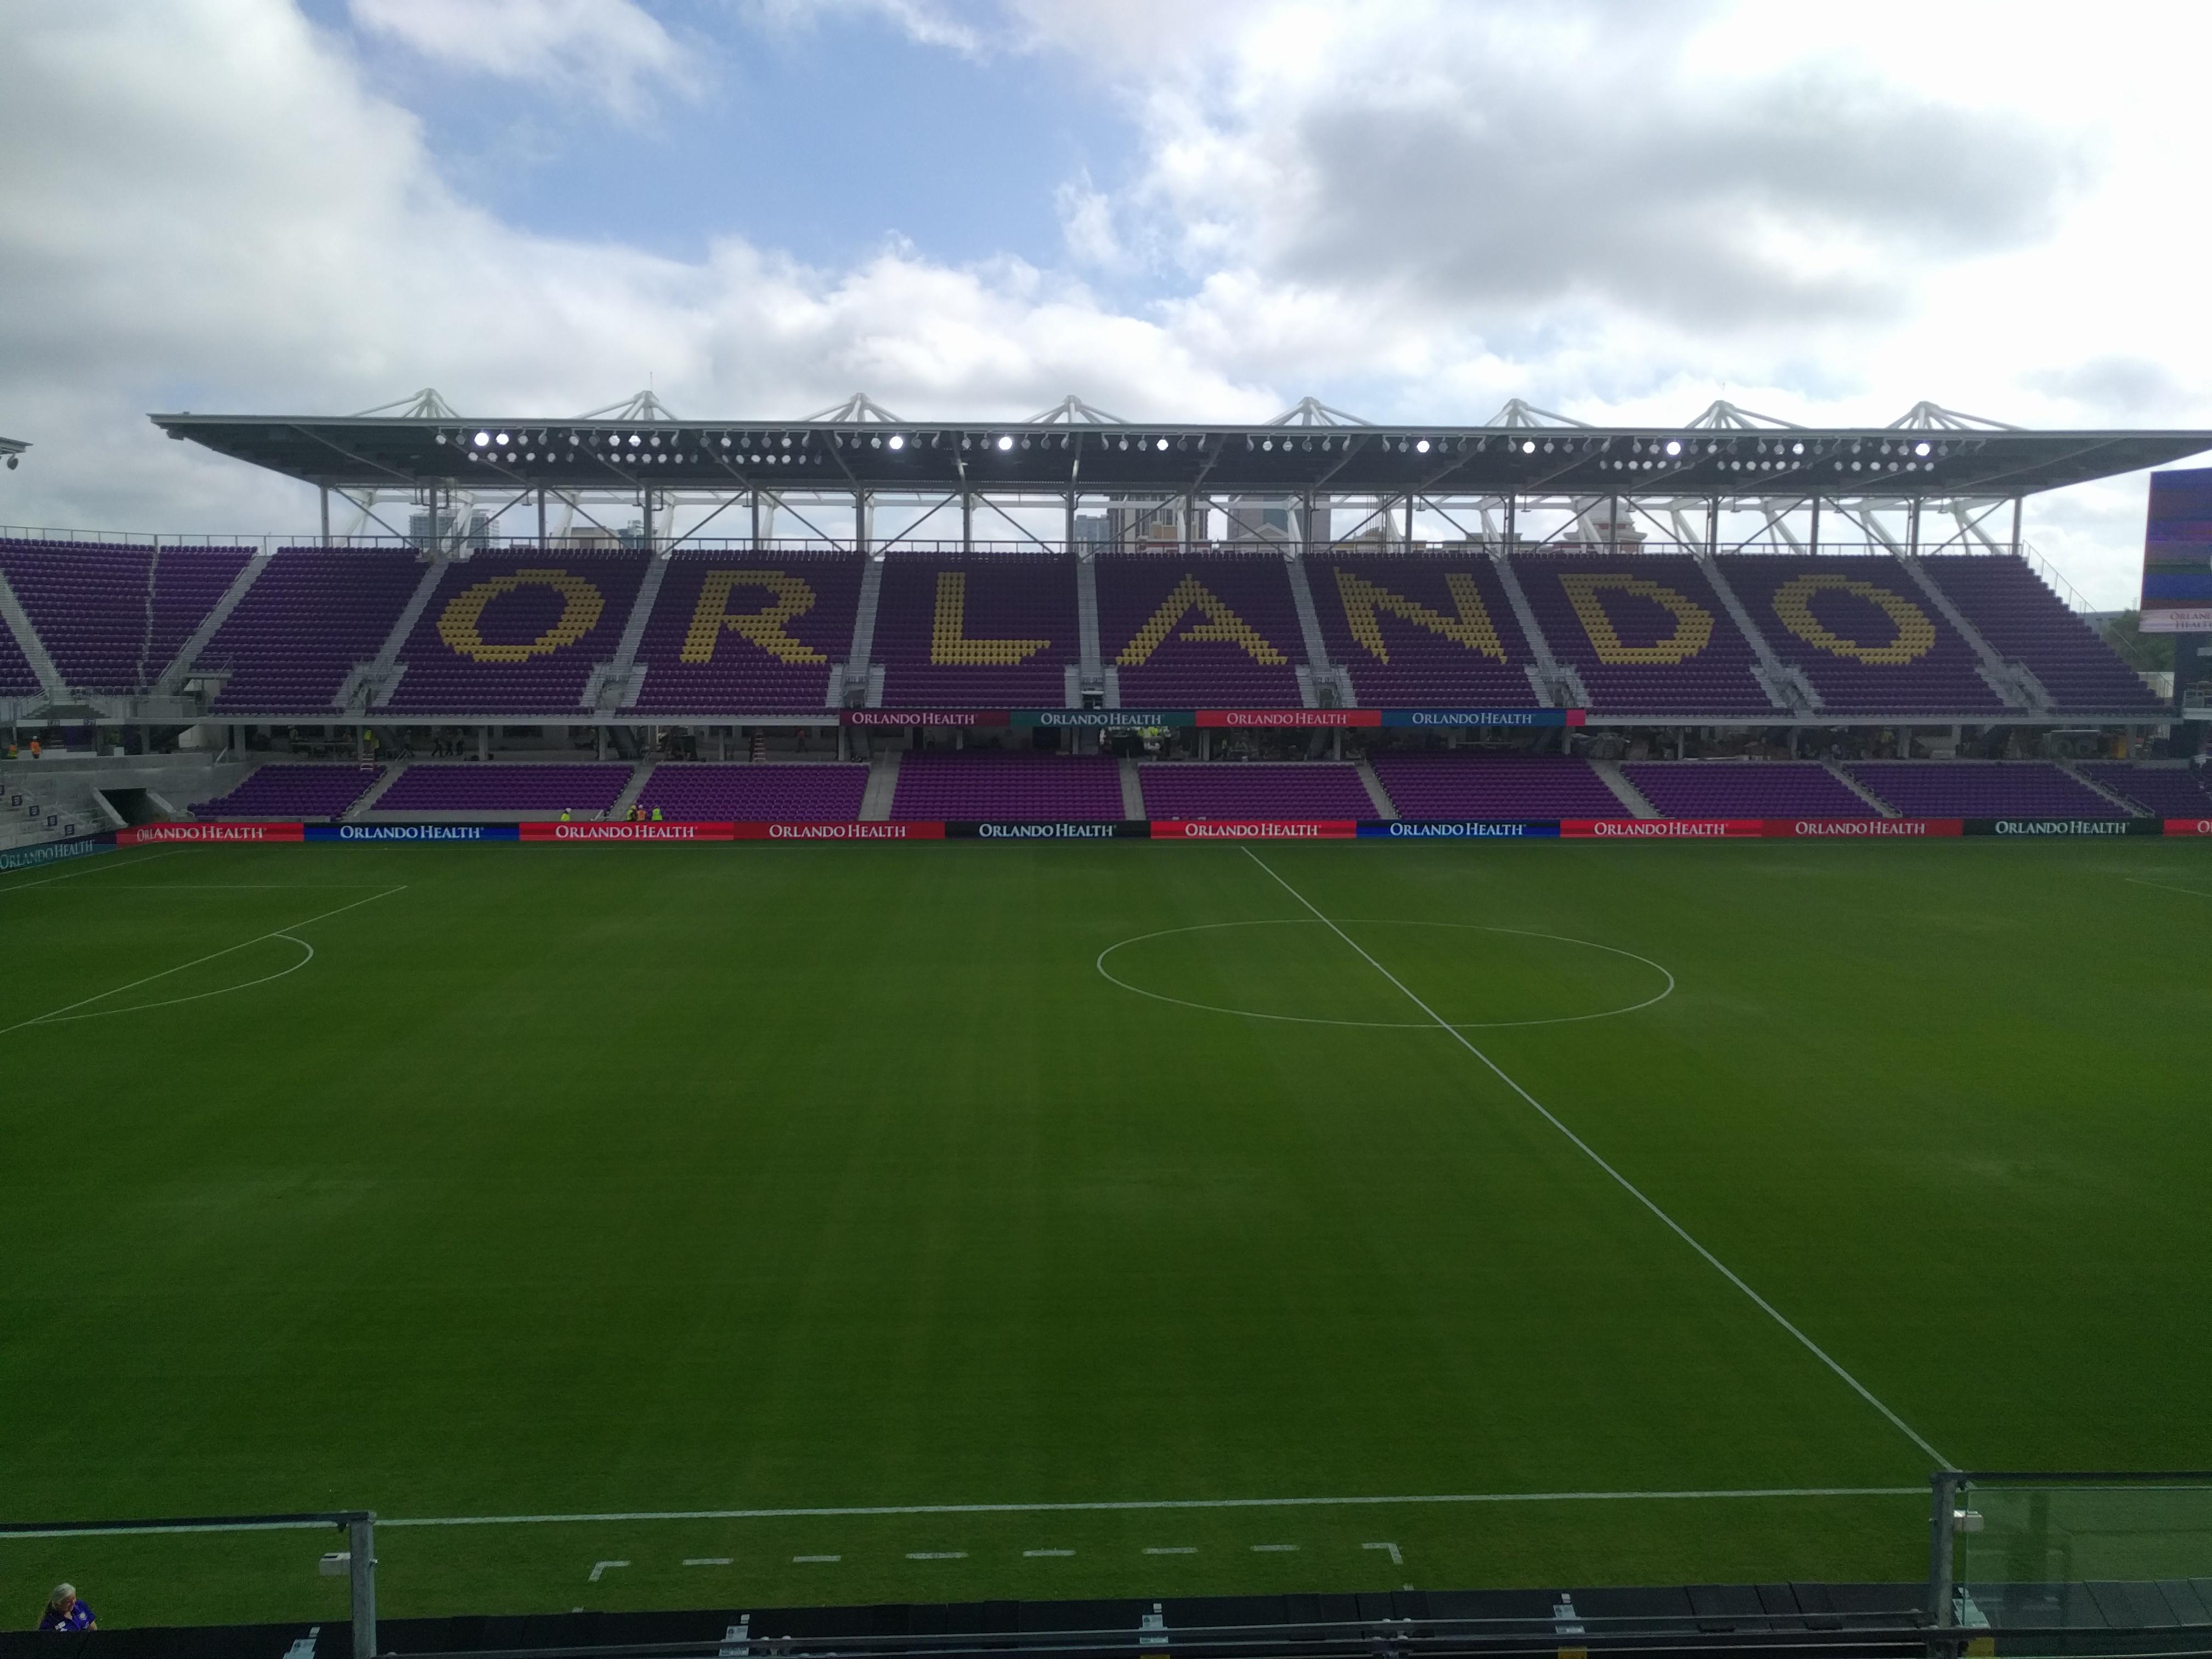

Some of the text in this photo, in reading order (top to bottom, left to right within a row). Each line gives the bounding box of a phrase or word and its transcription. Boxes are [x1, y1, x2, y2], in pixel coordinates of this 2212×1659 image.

[436, 567, 1936, 665] ORLANDO
[852, 713, 974, 724] ORLANDO HEALTH
[1041, 713, 1161, 725] ORLANDO HEALTH
[1227, 713, 1346, 724] ORLANDO HEALTH
[1412, 713, 1532, 724] ORLANDO HEALTH
[340, 826, 481, 838] ORLANDO HEALTH
[555, 825, 694, 838] ORLANDO HEALTH
[769, 825, 906, 837] ORLANDO HEALTH
[979, 824, 1113, 837] ORLANDO HEALTH
[1185, 823, 1318, 836] ORLANDO HEALTH
[1390, 823, 1522, 836] ORLANDO HEALTH
[1594, 822, 1724, 835] ORLANDO HEALTH
[1795, 822, 1925, 834] ORLANDO HEALTH
[1995, 821, 2126, 833] ORLANDO HEALTH
[137, 826, 263, 842] ORLANDO HEALTH
[0, 839, 93, 869] ORLANDO HEALTH
